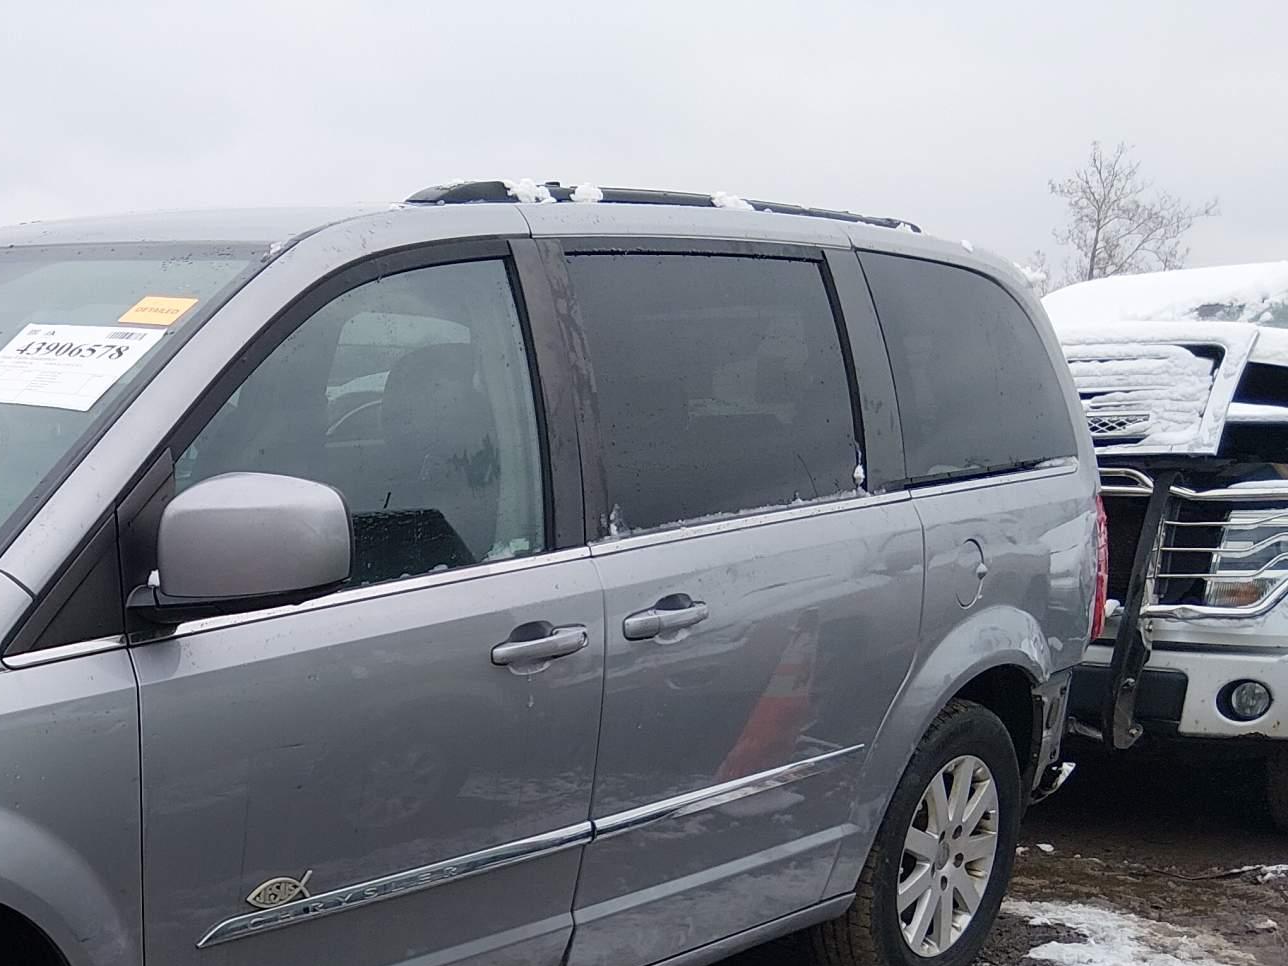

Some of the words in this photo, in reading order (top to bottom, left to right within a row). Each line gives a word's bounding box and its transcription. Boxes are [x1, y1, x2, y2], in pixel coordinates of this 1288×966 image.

[16, 341, 130, 360] 43906578
[248, 866, 458, 930] CHRYSLER
[255, 881, 296, 905] JESUS
